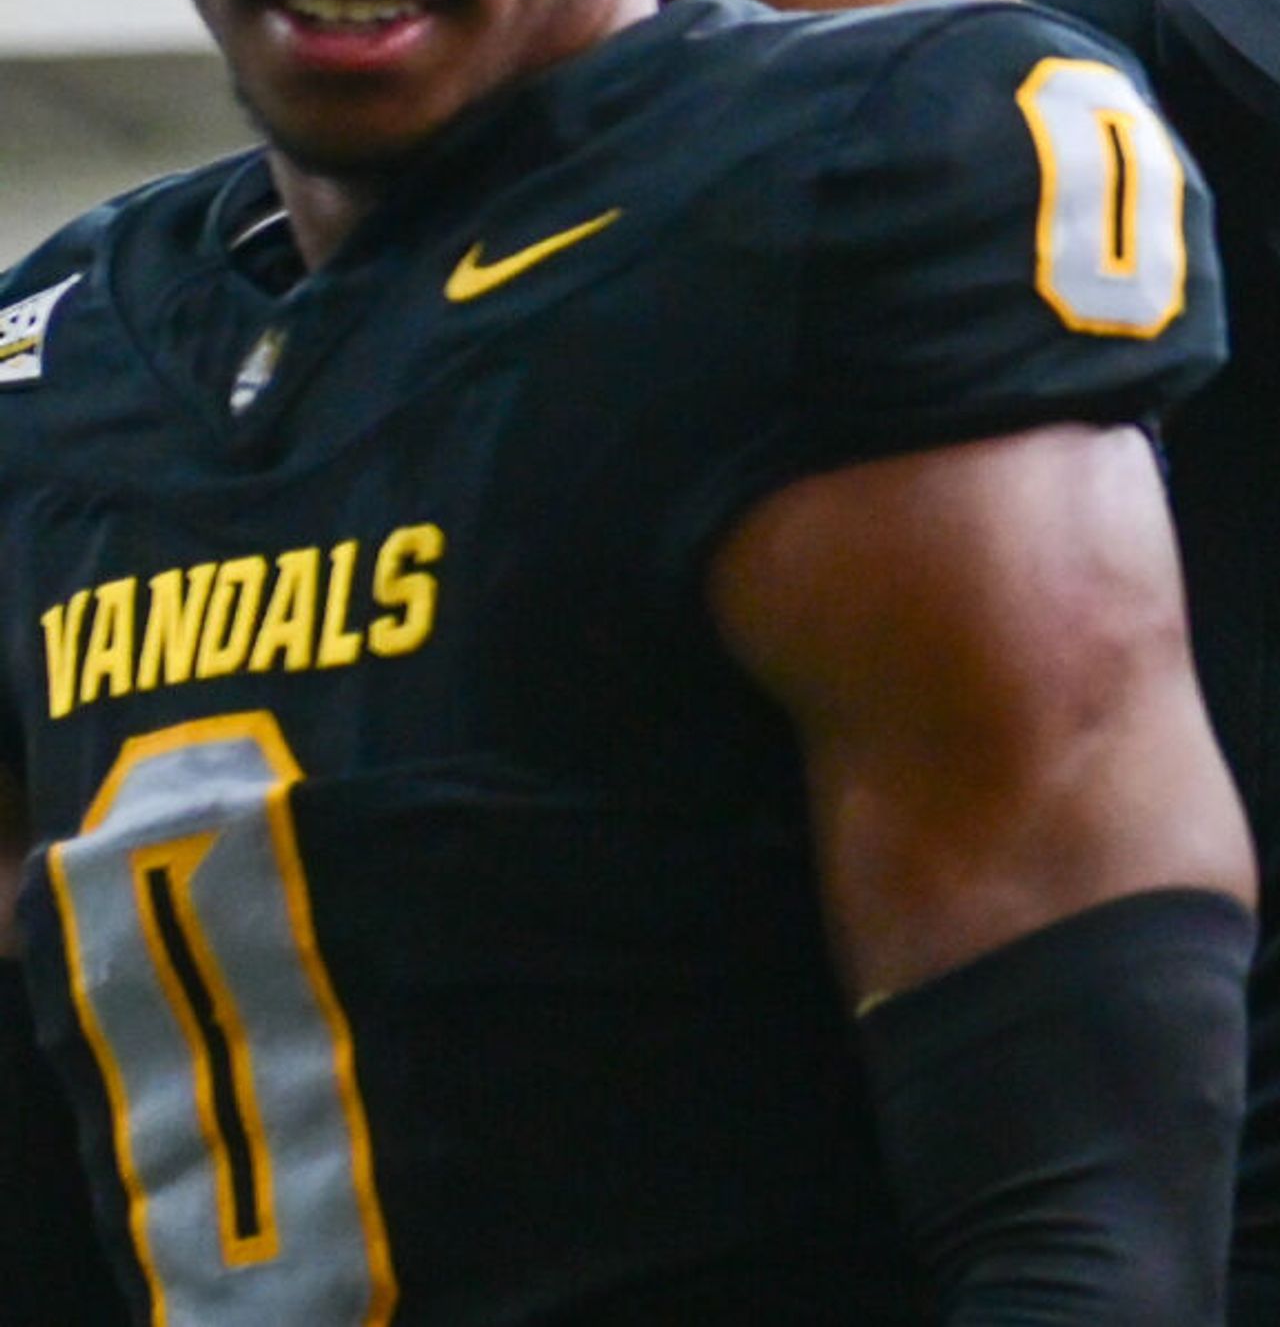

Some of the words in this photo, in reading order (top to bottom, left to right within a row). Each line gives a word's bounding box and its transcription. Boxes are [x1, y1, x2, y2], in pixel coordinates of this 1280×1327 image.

[1014, 56, 1187, 340] 0
[41, 522, 444, 719] VANDALS
[48, 710, 397, 1327] 0
